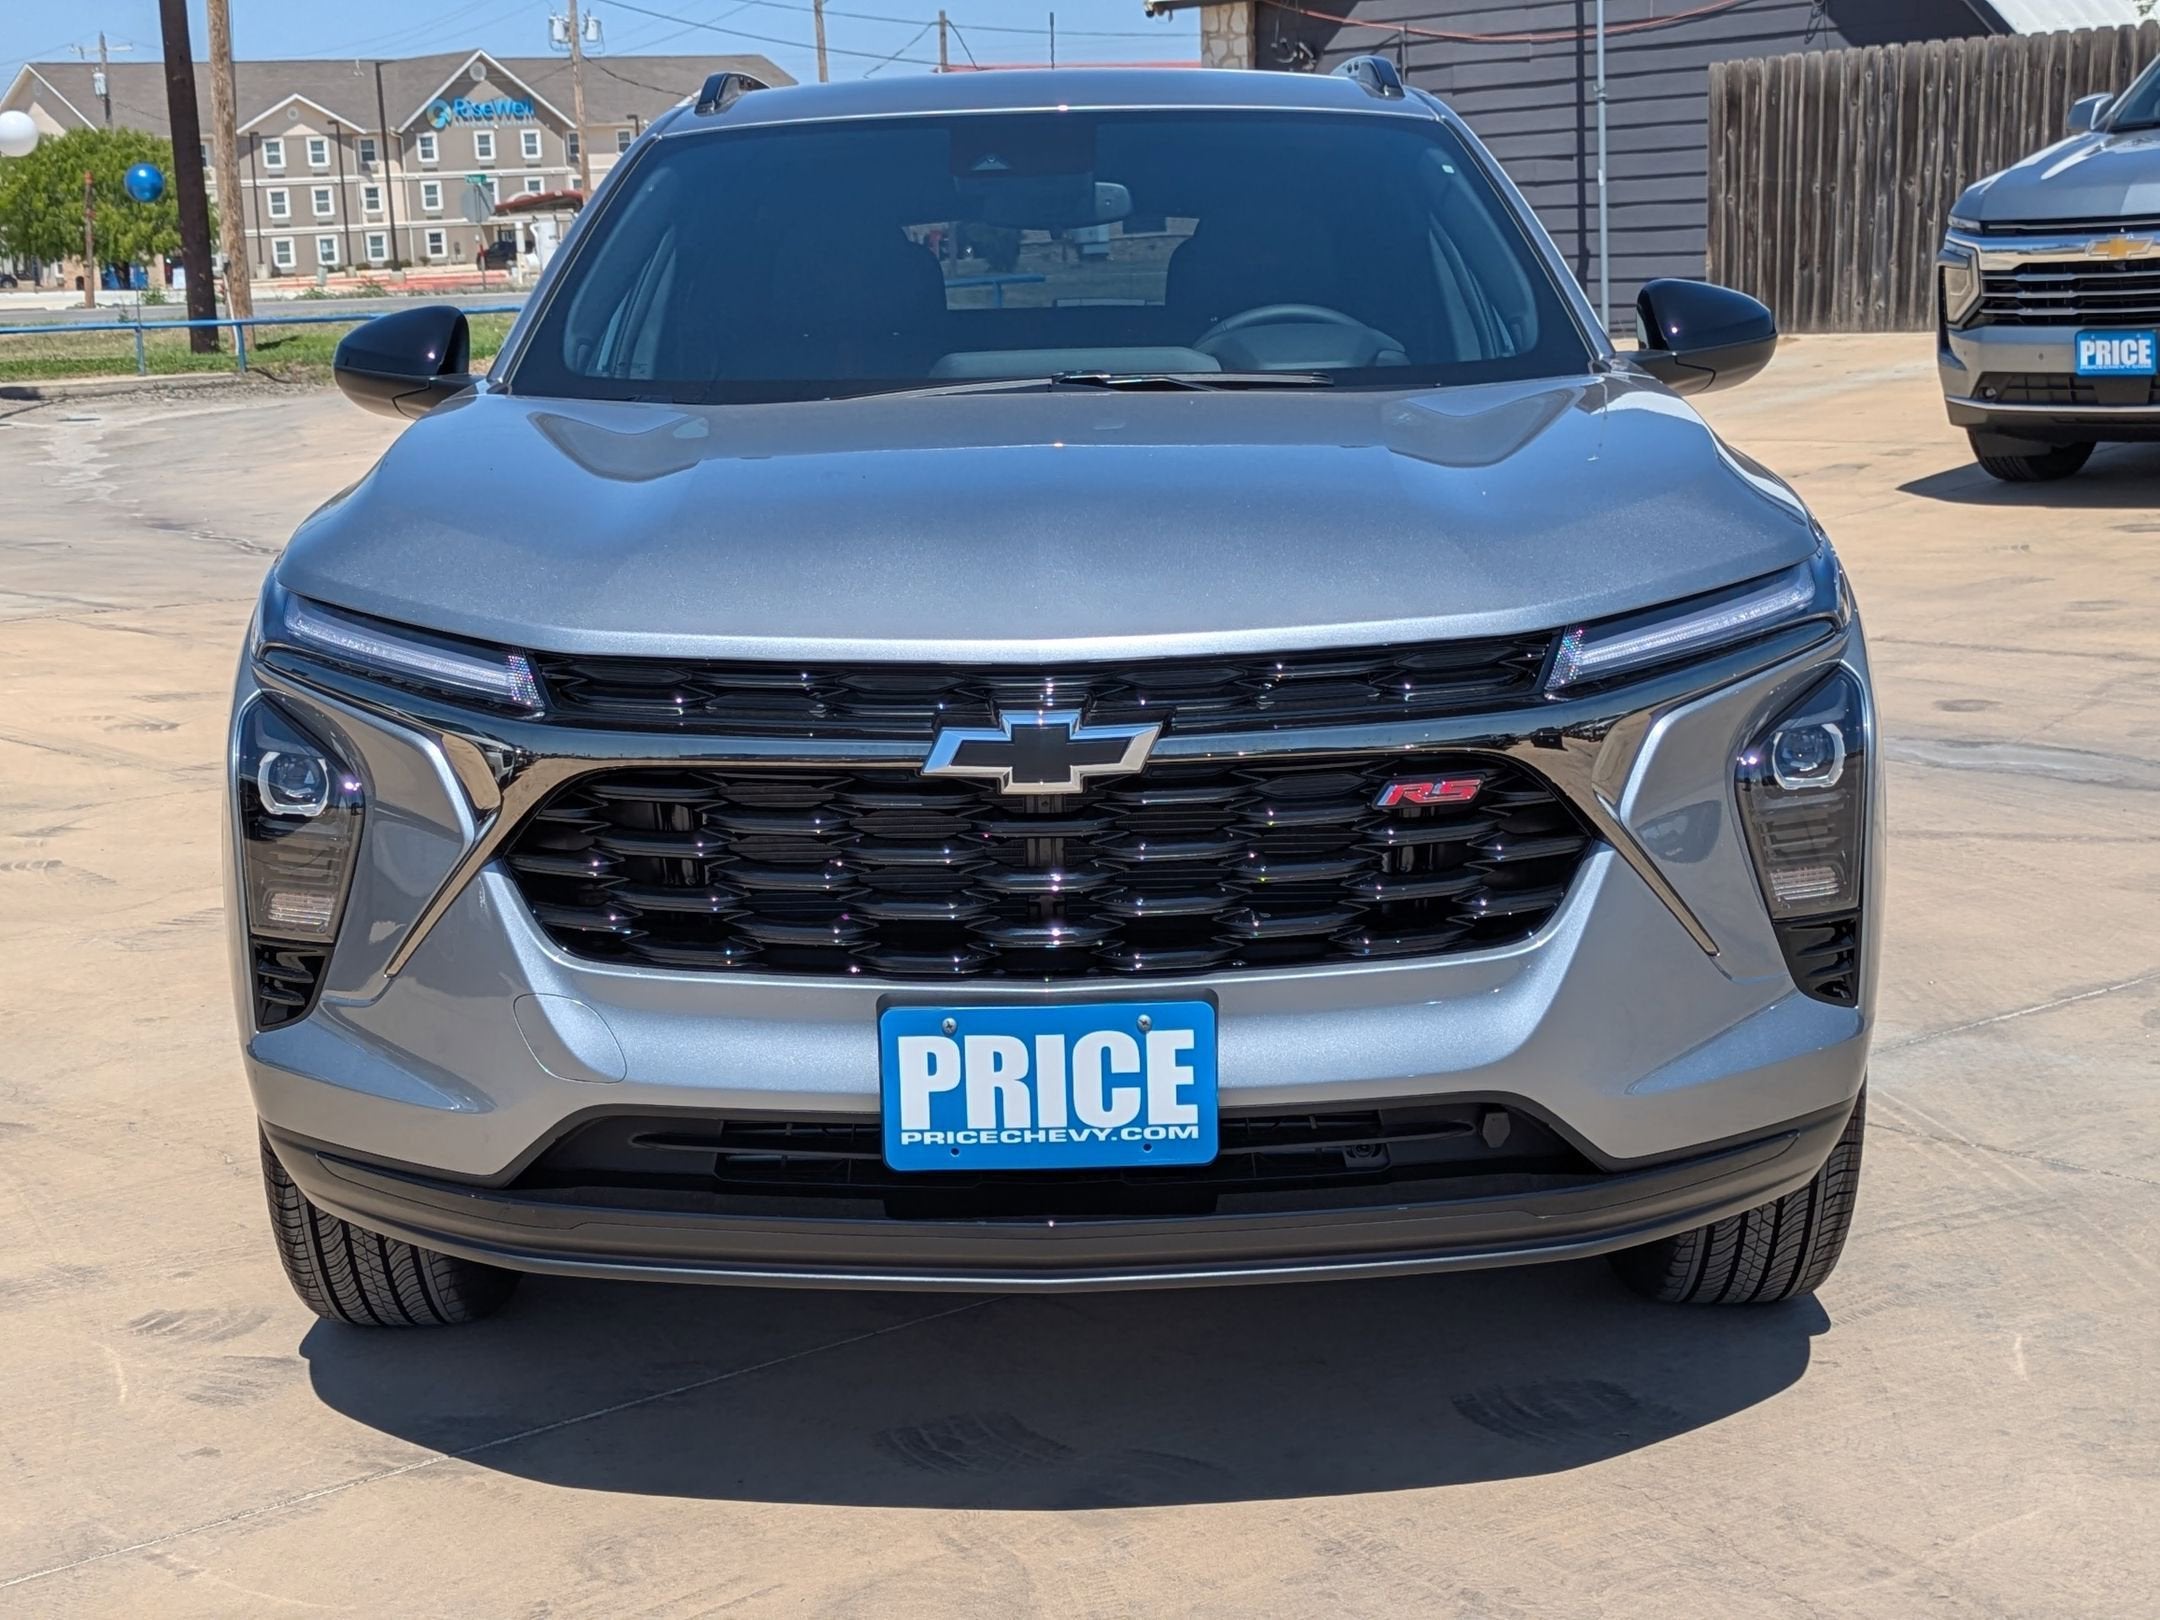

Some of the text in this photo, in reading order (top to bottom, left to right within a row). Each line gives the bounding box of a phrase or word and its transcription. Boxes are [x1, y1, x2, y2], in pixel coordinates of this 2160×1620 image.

[2080, 339, 2151, 366] PRICE
[1377, 779, 1481, 806] RS
[897, 1029, 1199, 1130] PRICE
[900, 1125, 1199, 1145] PRICECHEVY.COM
